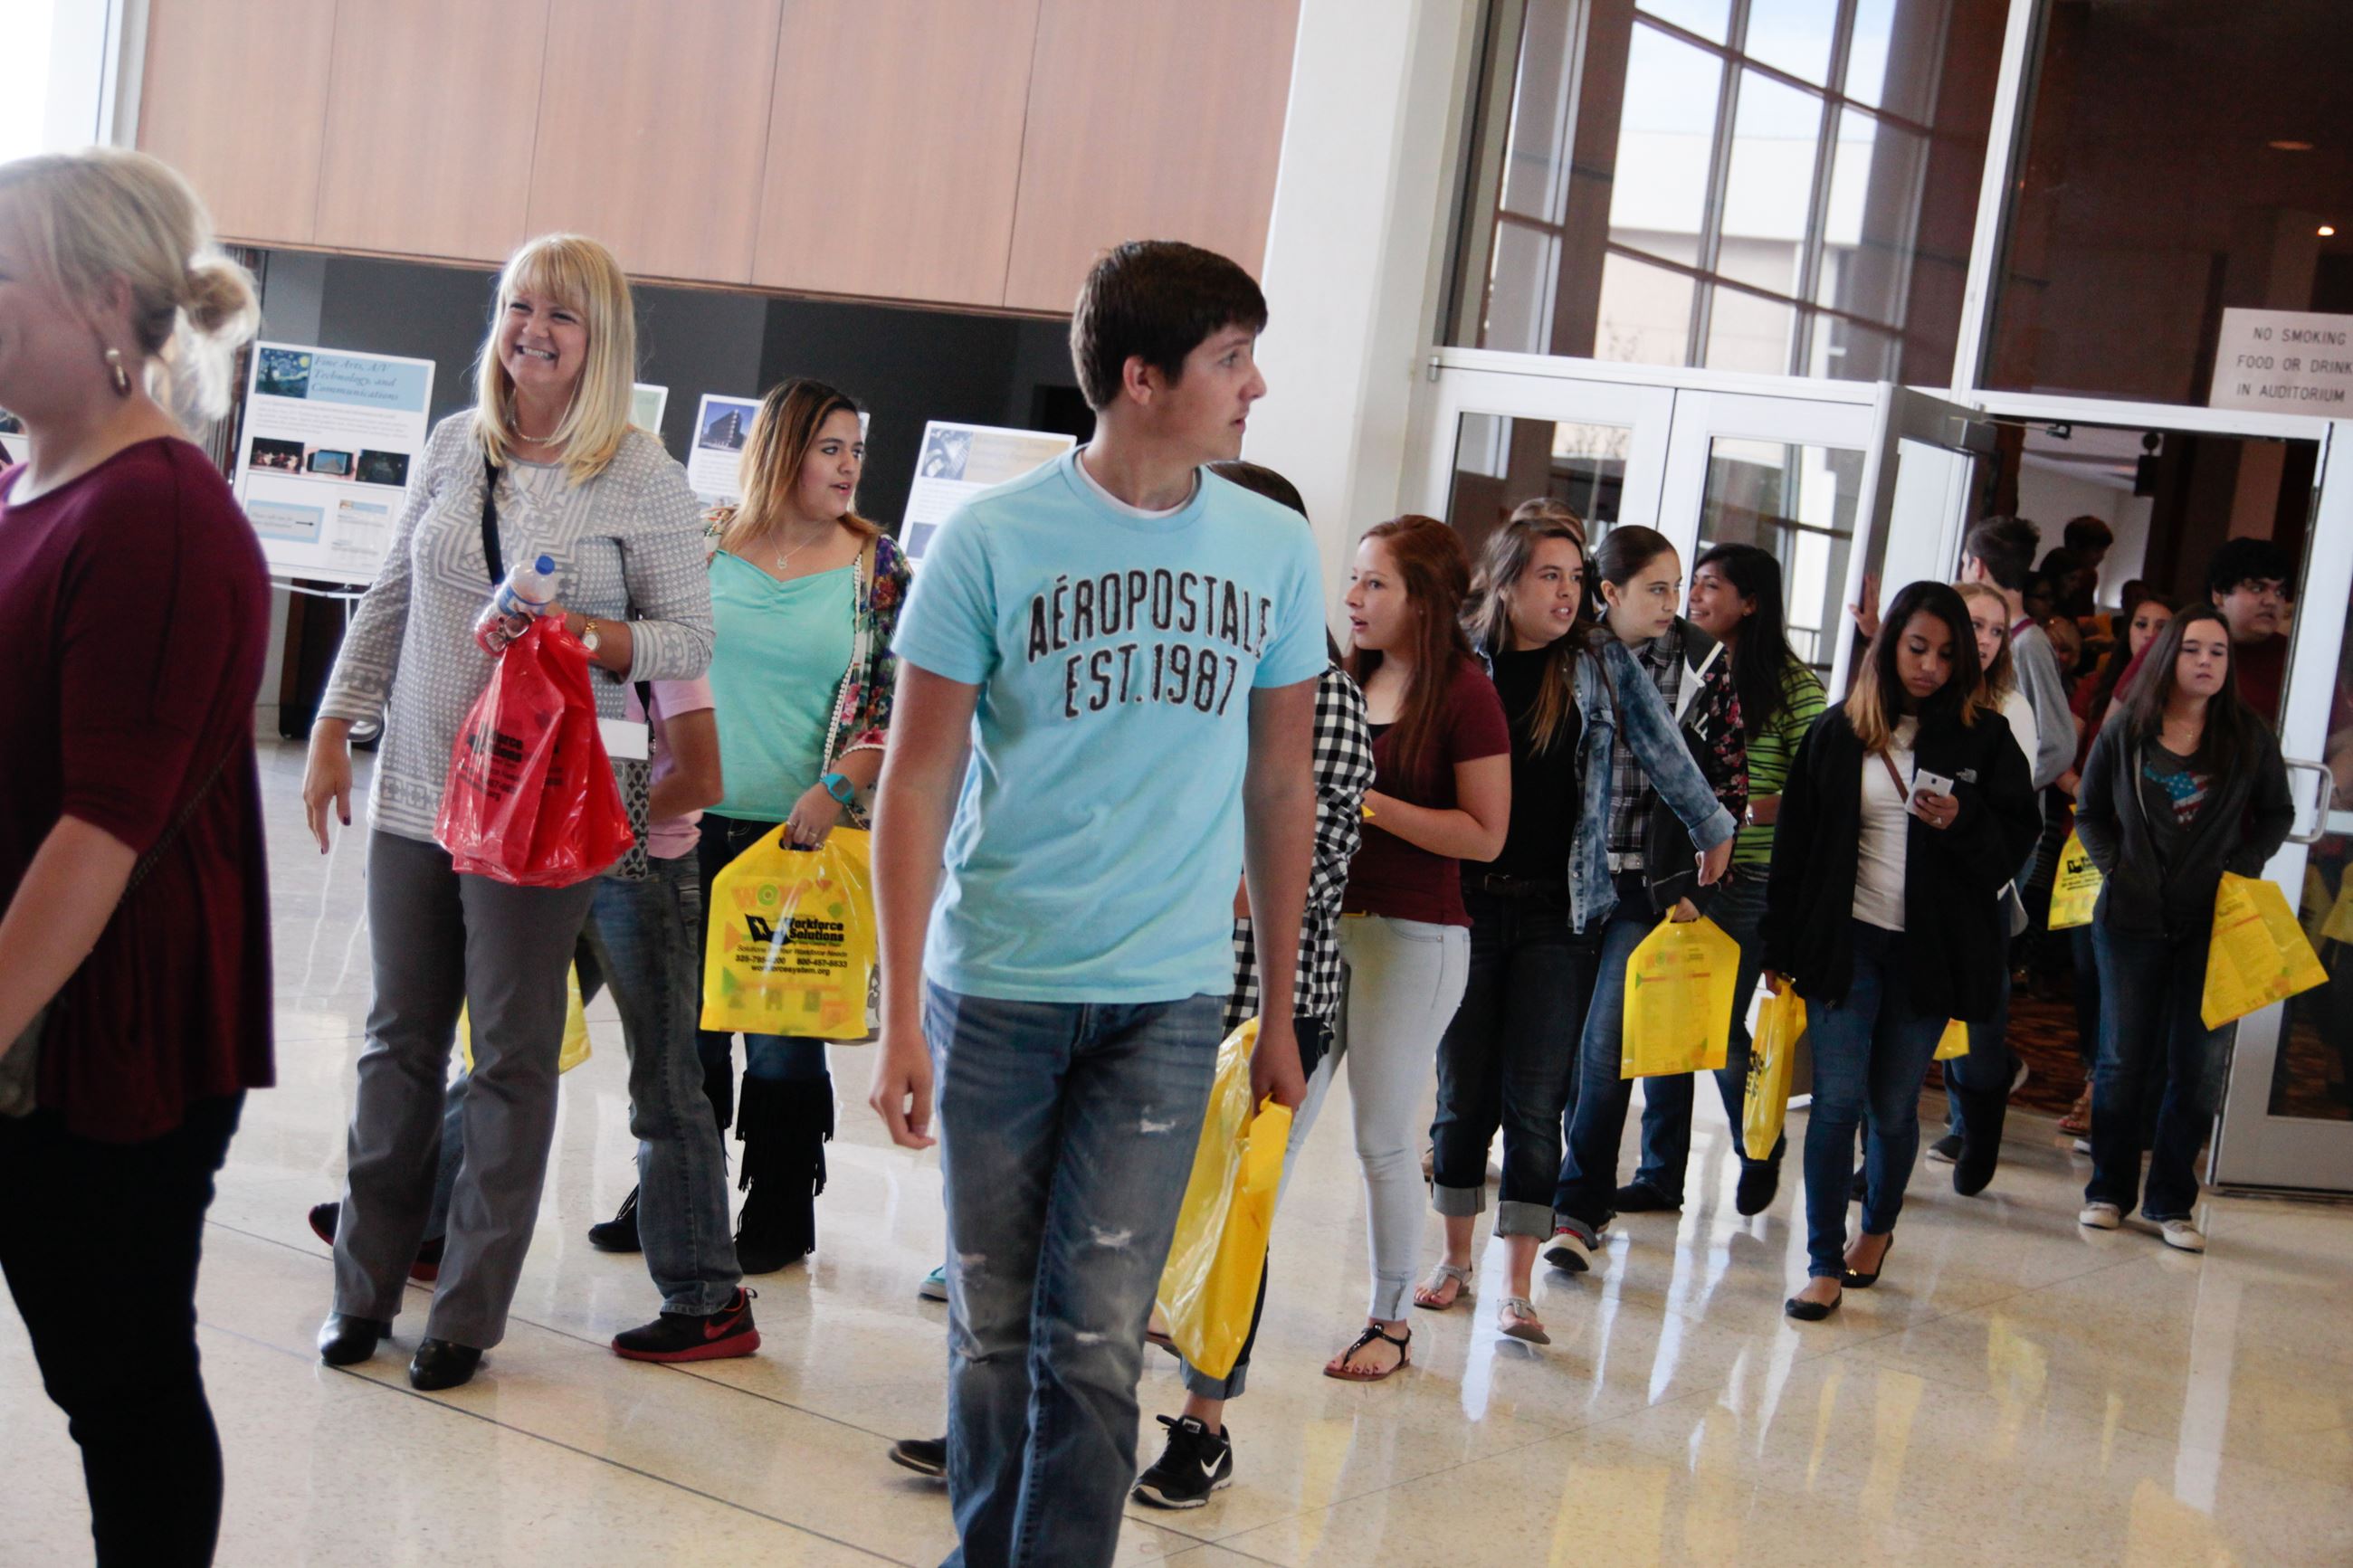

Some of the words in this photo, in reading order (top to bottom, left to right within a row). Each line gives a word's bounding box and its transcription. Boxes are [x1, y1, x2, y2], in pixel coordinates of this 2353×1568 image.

[2253, 327, 2272, 341] NO
[2282, 328, 2347, 346] SMOKING
[2236, 355, 2274, 370] FOOD
[2282, 357, 2301, 371] OR
[2310, 359, 2353, 375] DRINK
[2236, 384, 2251, 396] IN
[2259, 385, 2346, 403] AUDITORIUM
[789, 928, 844, 942] Solutions
